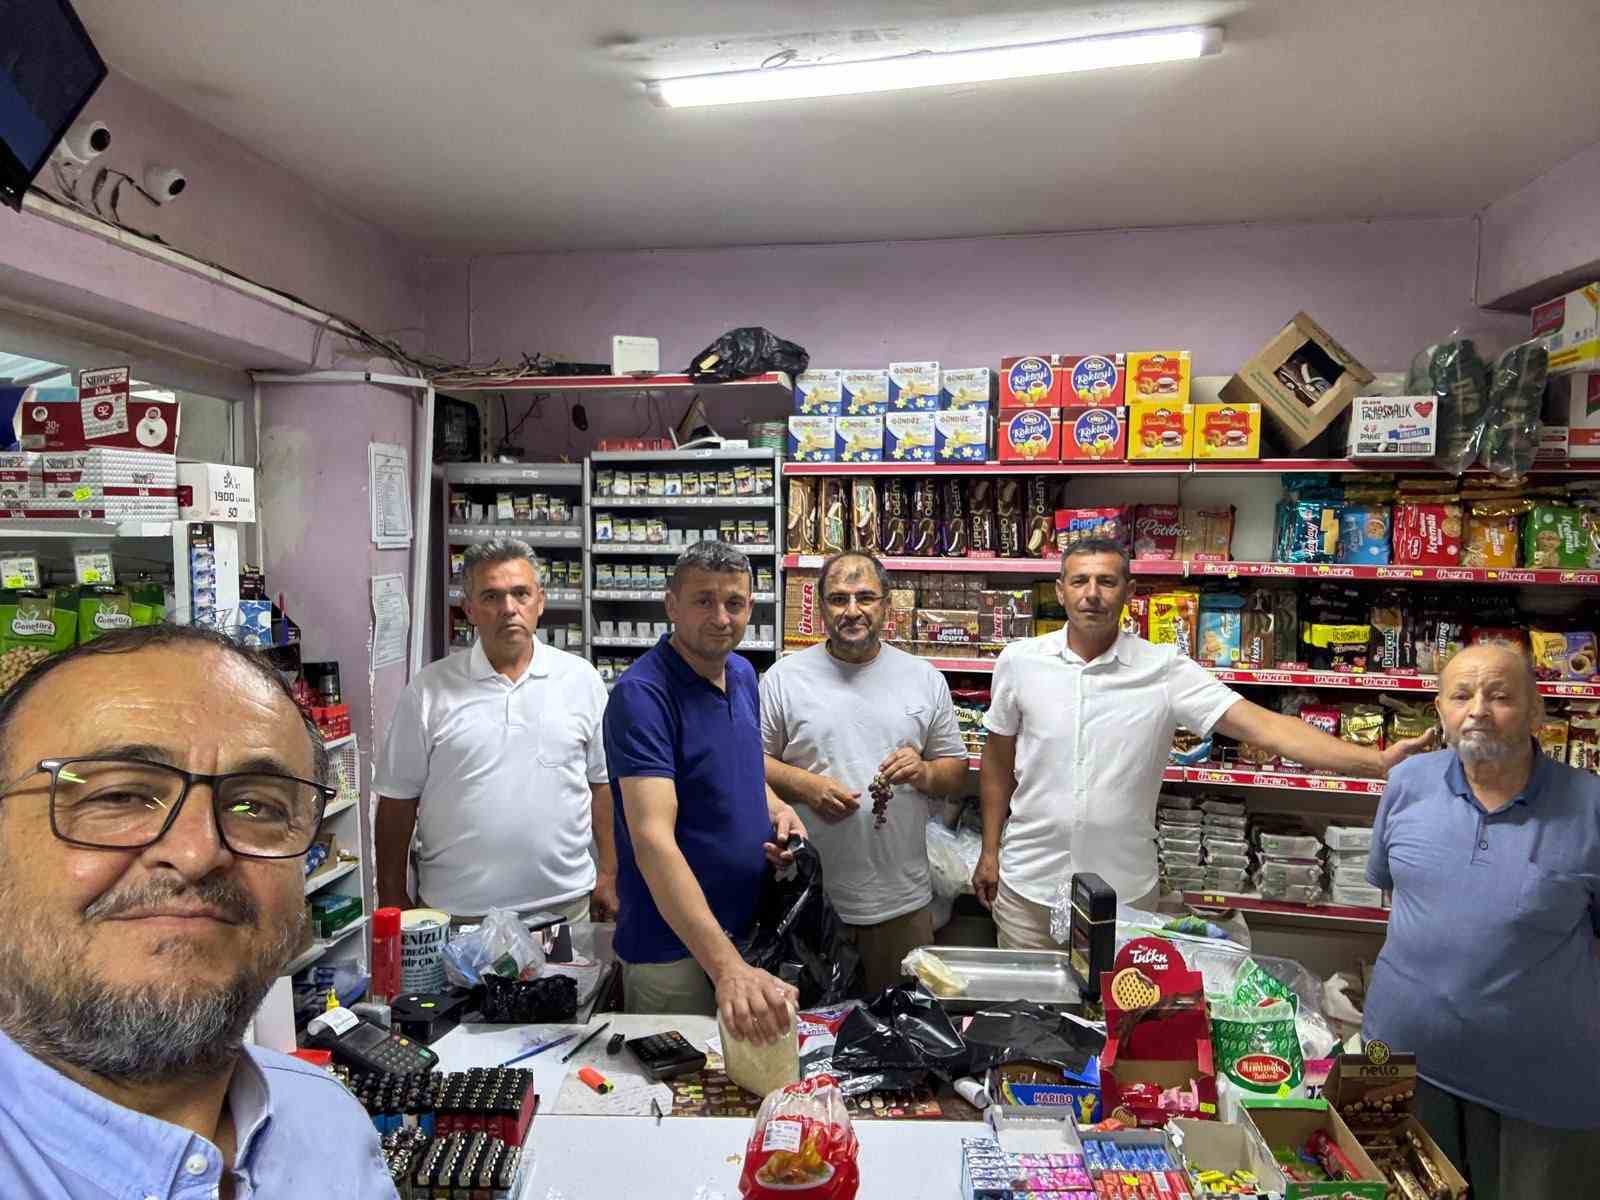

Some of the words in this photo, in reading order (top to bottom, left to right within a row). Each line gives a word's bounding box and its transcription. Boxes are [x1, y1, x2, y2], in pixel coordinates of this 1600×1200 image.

[799, 584, 813, 635] ÜLKER
[1129, 949, 1168, 964] Tutku
[1034, 1093, 1073, 1104] HARIBO
